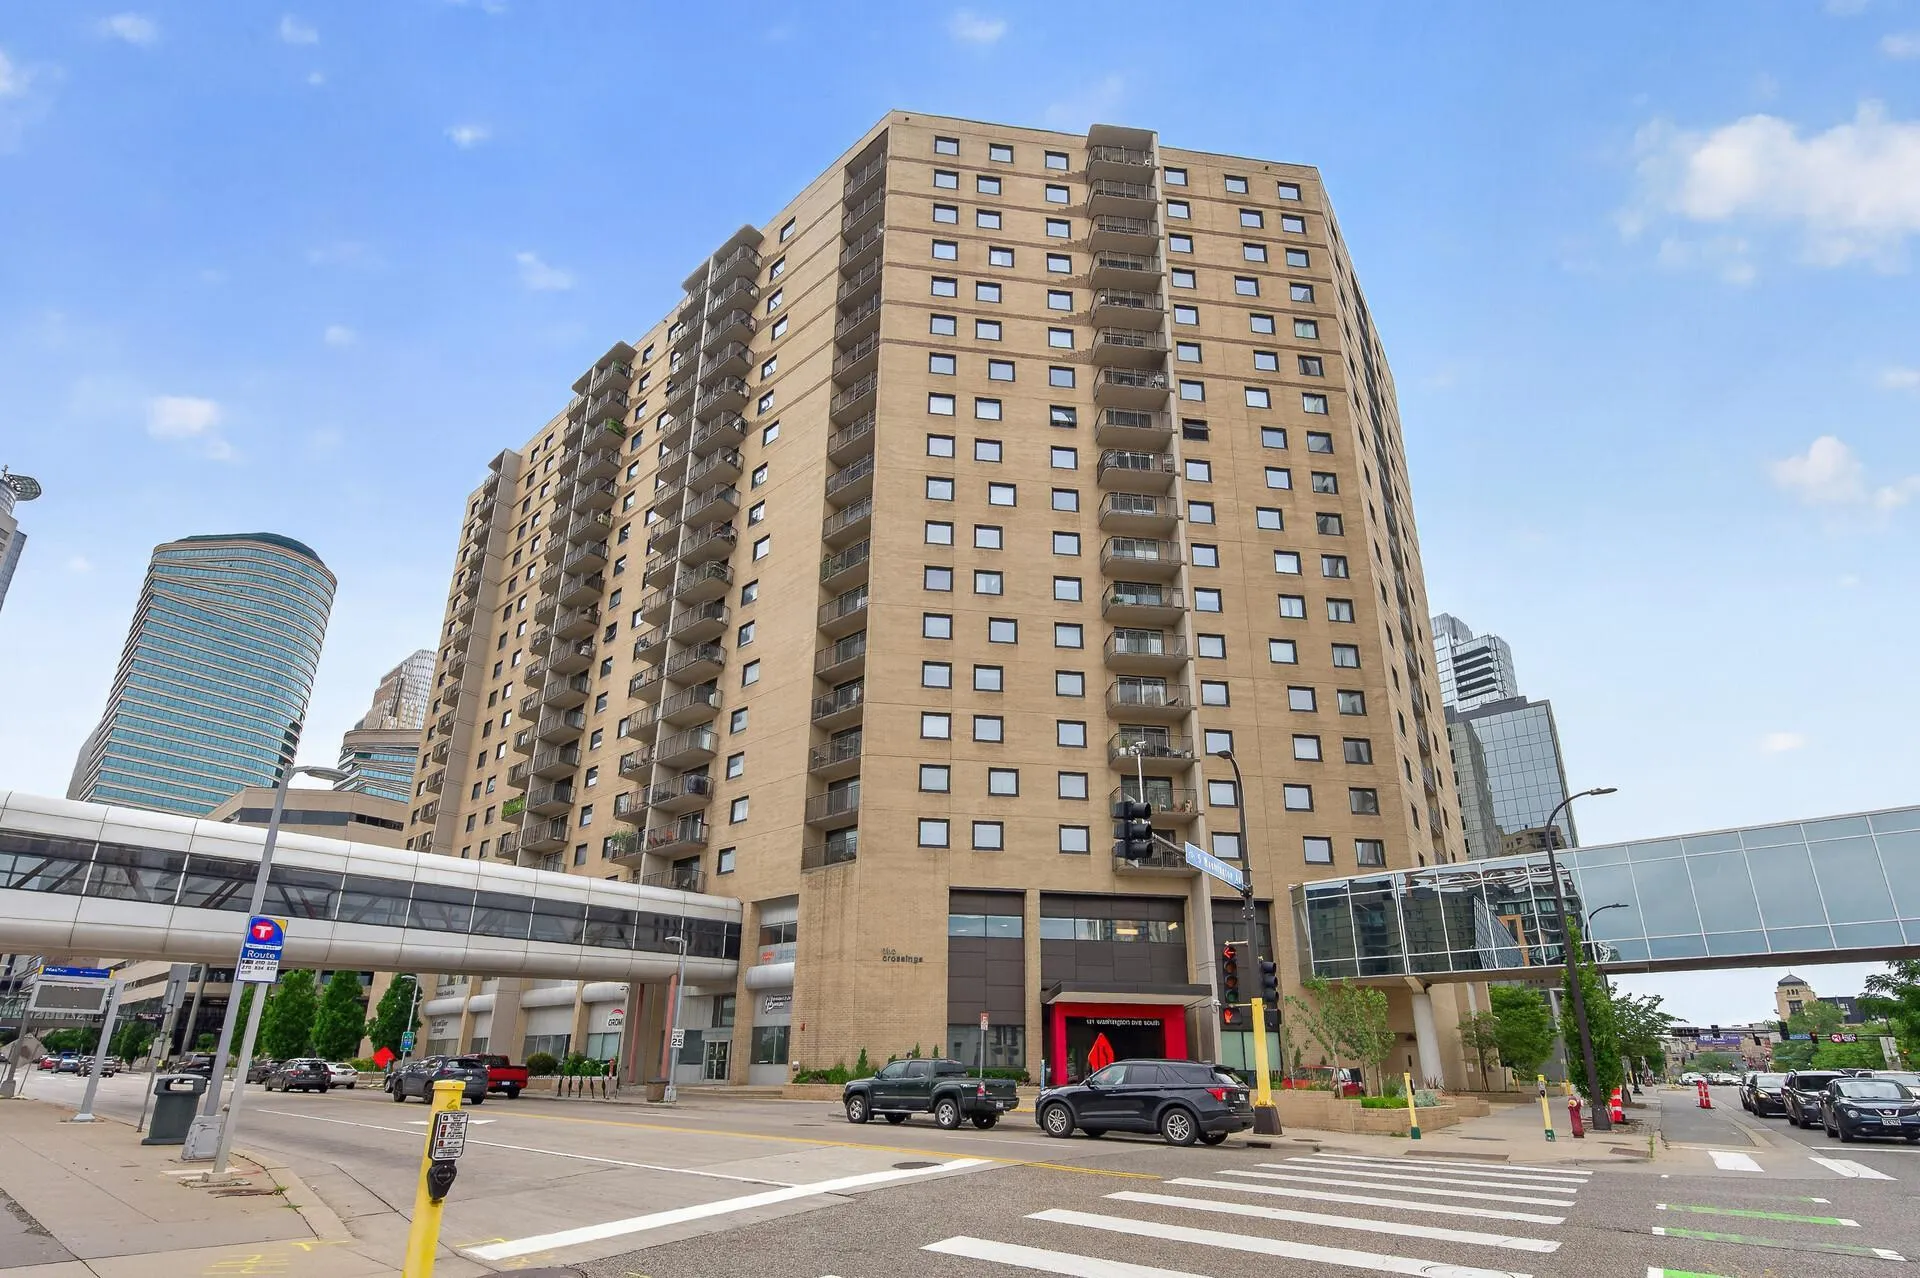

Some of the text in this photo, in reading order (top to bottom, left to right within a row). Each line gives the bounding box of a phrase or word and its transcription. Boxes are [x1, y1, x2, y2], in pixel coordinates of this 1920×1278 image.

[247, 949, 276, 959] Route
[882, 955, 924, 964] crossings
[671, 1038, 683, 1047] 25
